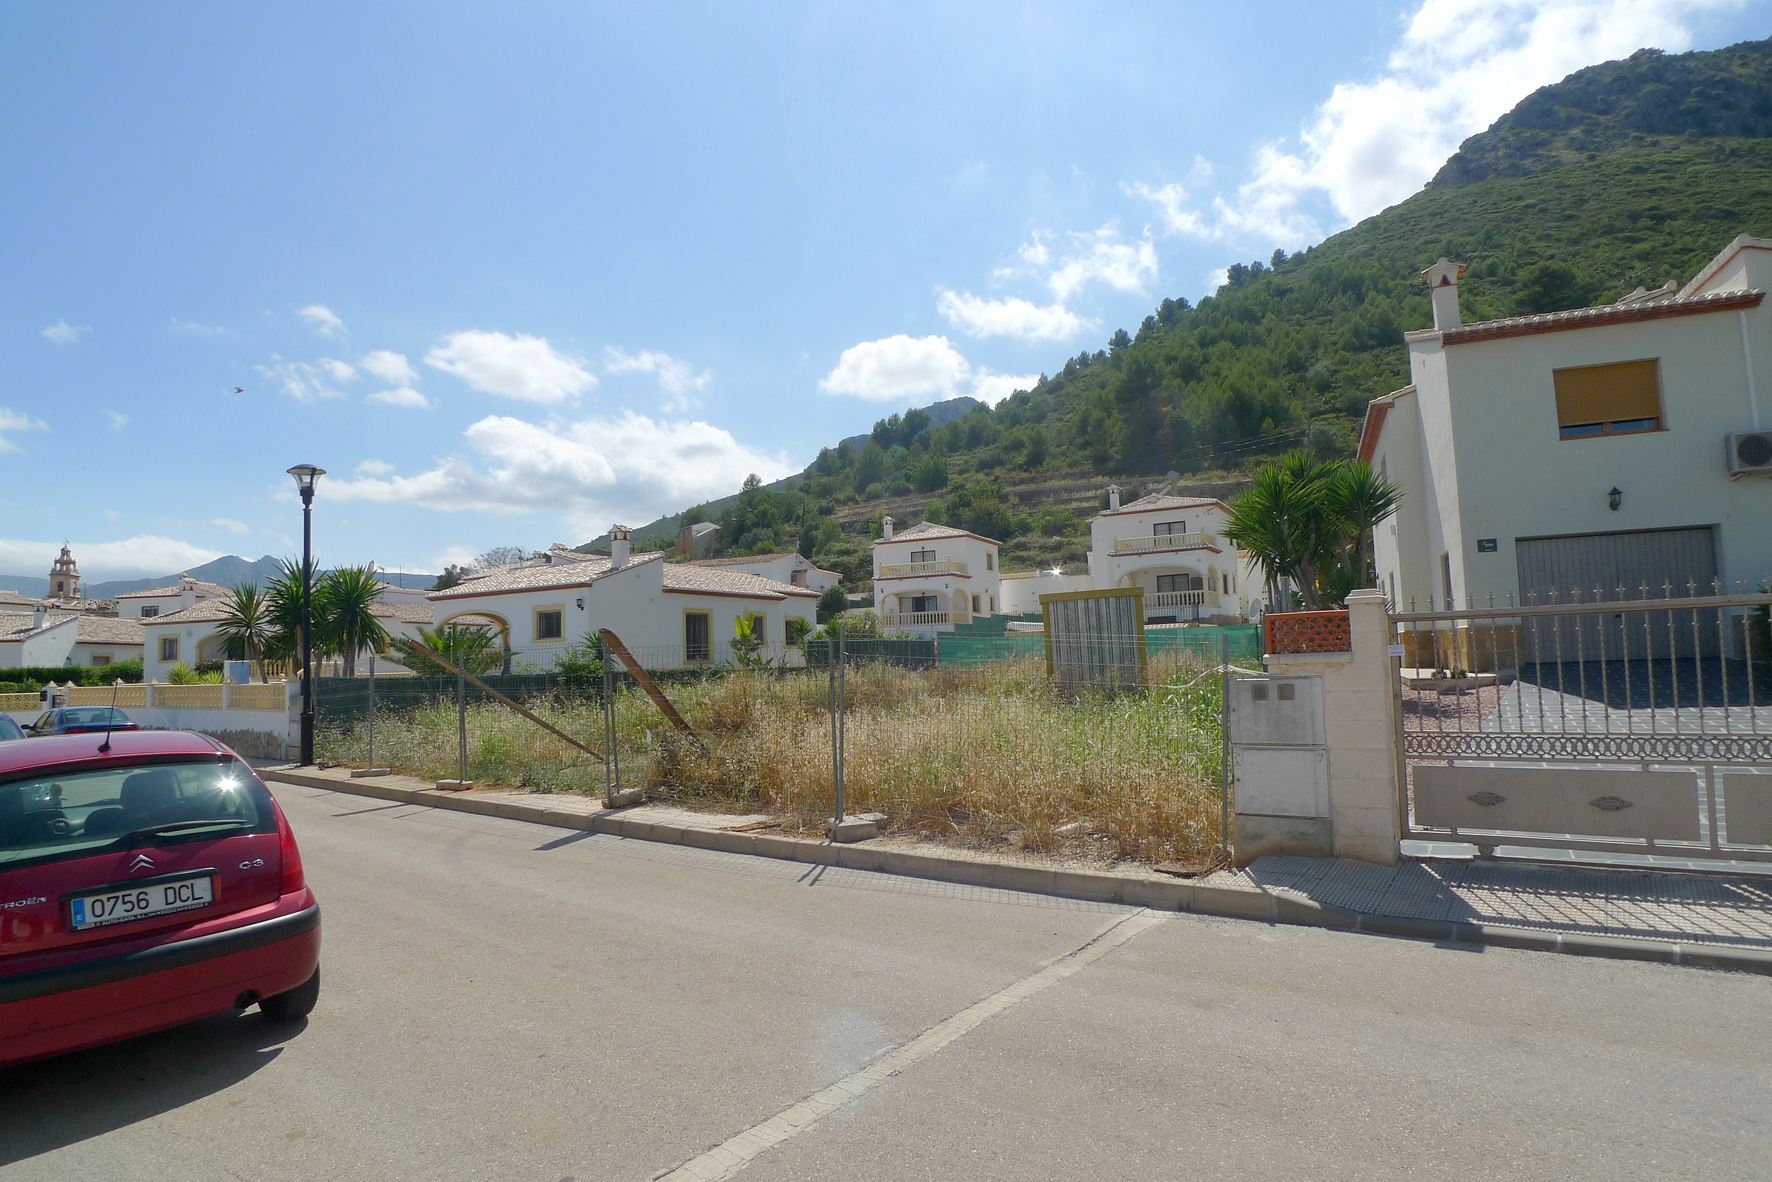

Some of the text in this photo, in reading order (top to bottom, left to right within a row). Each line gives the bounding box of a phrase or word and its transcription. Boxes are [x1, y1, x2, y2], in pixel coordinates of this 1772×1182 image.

[239, 858, 264, 870] C3
[91, 891, 149, 918] 0756
[163, 882, 204, 906] DCL
